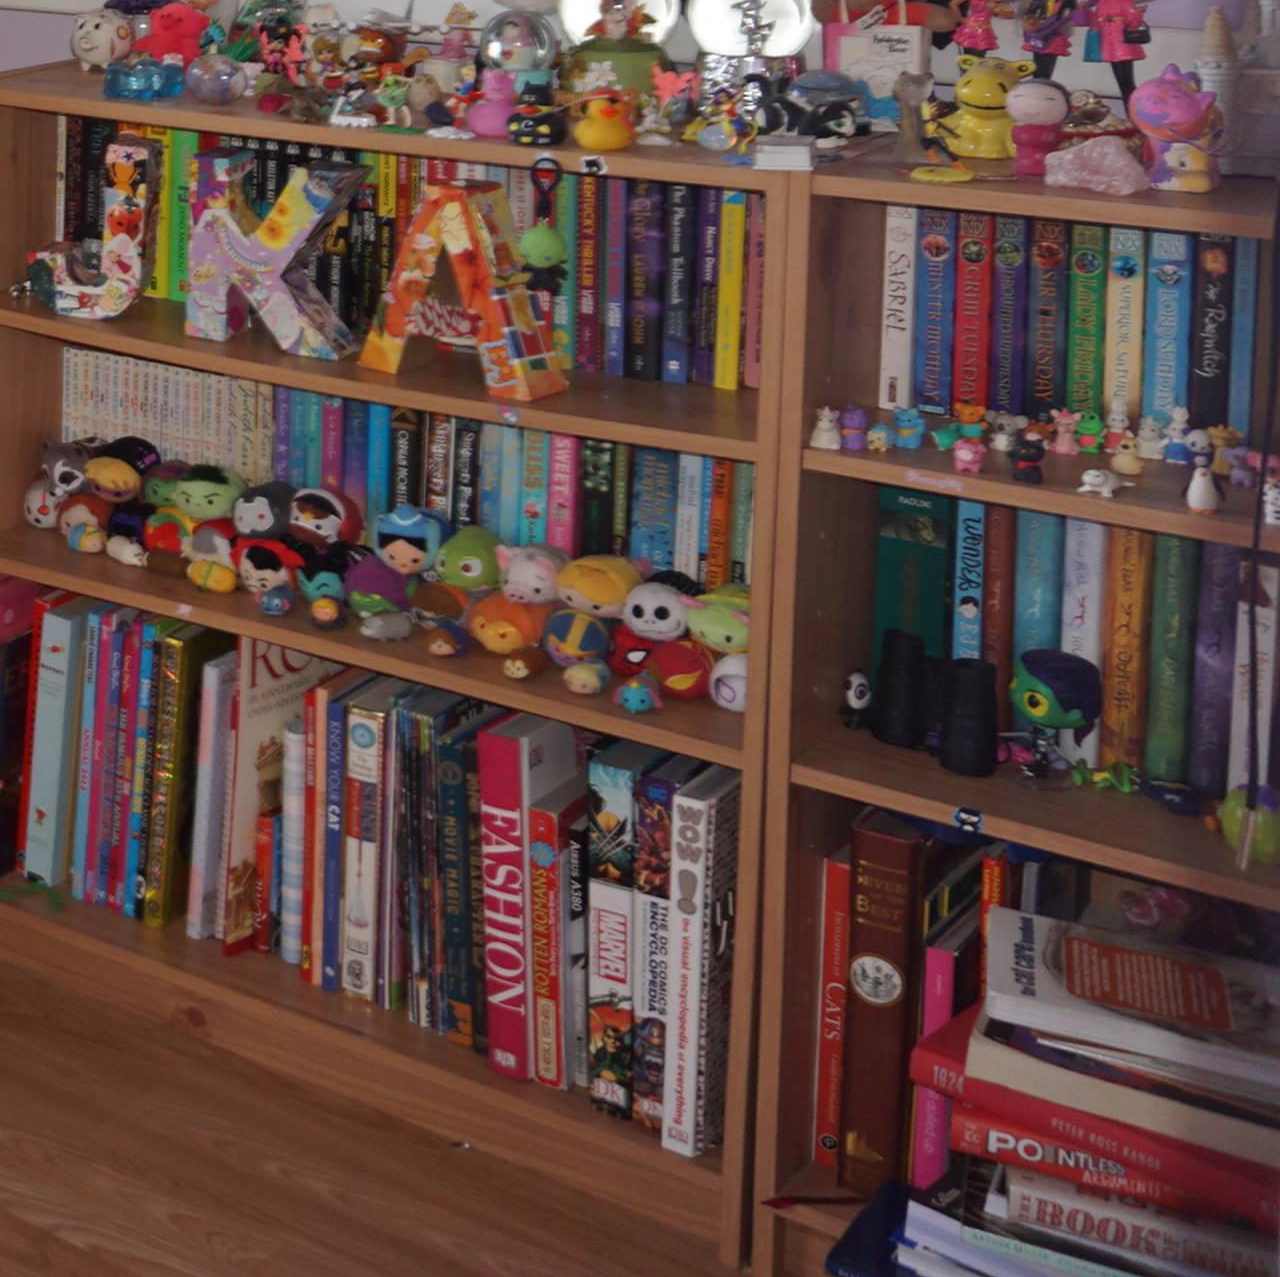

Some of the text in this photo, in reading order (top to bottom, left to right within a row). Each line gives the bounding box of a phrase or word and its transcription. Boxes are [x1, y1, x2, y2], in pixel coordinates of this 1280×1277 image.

[266, 160, 278, 204] SKELETON KEY
[177, 231, 185, 274] MOMENT
[582, 177, 594, 286] KENTUCKY THRILLER
[671, 185, 686, 305] The Phantom Tollbooth
[704, 226, 716, 282] NANCY DREW
[630, 198, 651, 345] Glory LAUREN JOHN
[886, 251, 911, 334] SABRIEL
[925, 262, 944, 402] MISTER MONDAY
[960, 266, 981, 404] GRIM TUESDAY
[997, 270, 1015, 408] DROWNED WEDNESDAY
[1035, 271, 1057, 402] SIR THURSDAY
[1072, 279, 1096, 411] LADY FRIDAY
[1118, 283, 1132, 347] SUPERIOR
[1193, 304, 1226, 378] Ragwitch
[1157, 290, 1177, 413] LORD SUNDAY
[238, 385, 255, 432] Judith
[397, 430, 408, 466] ORPHAN
[427, 422, 449, 493] Skulduggery
[524, 433, 544, 489] BLISS
[555, 437, 570, 496] SWEET
[897, 495, 932, 509] PAOLINI
[711, 518, 725, 568] michael
[958, 517, 982, 591] WONDER
[162, 648, 178, 721] GUINNESS
[1114, 651, 1133, 711] OUTCAST
[328, 720, 343, 832] KNOW YOUR CAT
[111, 804, 122, 847] ANNUAL
[154, 785, 169, 854] RECORDS
[445, 815, 460, 916] MOVIE MAGIC
[569, 840, 583, 912] AIRBUS A380
[480, 801, 525, 1016] FASHION
[533, 868, 550, 996] ROTTEN ROMANS
[681, 917, 691, 933] the
[831, 910, 846, 966] ENCYCLOPEDIA
[855, 895, 903, 922] BEST
[599, 911, 627, 982] MARVEL
[647, 900, 659, 1014] ENCYCLOPEDIA
[657, 905, 669, 1016] THE DC COMICS
[680, 935, 694, 970] visual
[1013, 943, 1035, 969] care
[676, 972, 691, 1049] encyclopedia
[823, 982, 848, 1041] CATS
[671, 1064, 687, 1125] everything
[922, 1102, 938, 1154] dolled up
[986, 1129, 1127, 1177] POINTLESS
[1051, 1117, 1085, 1141] PETER
[1089, 1131, 1120, 1155] ROSS
[1123, 1143, 1162, 1171] RANGE
[1081, 1169, 1162, 1199] ARGUMENTS
[1018, 1193, 1032, 1222] THE
[1034, 1196, 1151, 1254] BOOK
